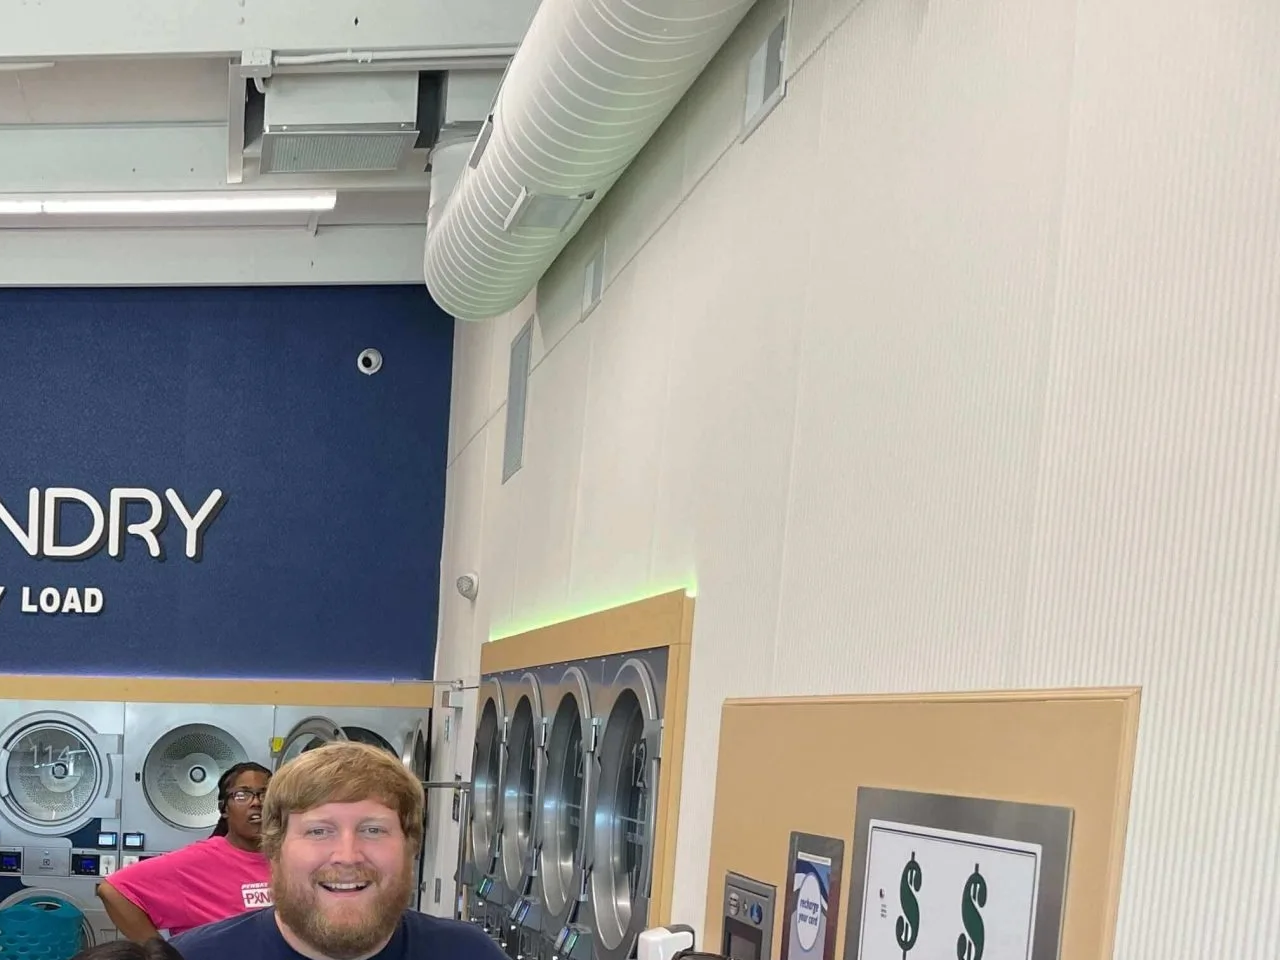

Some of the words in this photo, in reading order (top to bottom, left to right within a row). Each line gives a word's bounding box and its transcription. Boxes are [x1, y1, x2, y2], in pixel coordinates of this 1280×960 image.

[21, 588, 104, 615] LOAD
[29, 745, 72, 765] 114
[799, 898, 820, 914] recharge
[798, 912, 808, 924] your
[808, 915, 818, 926] card
